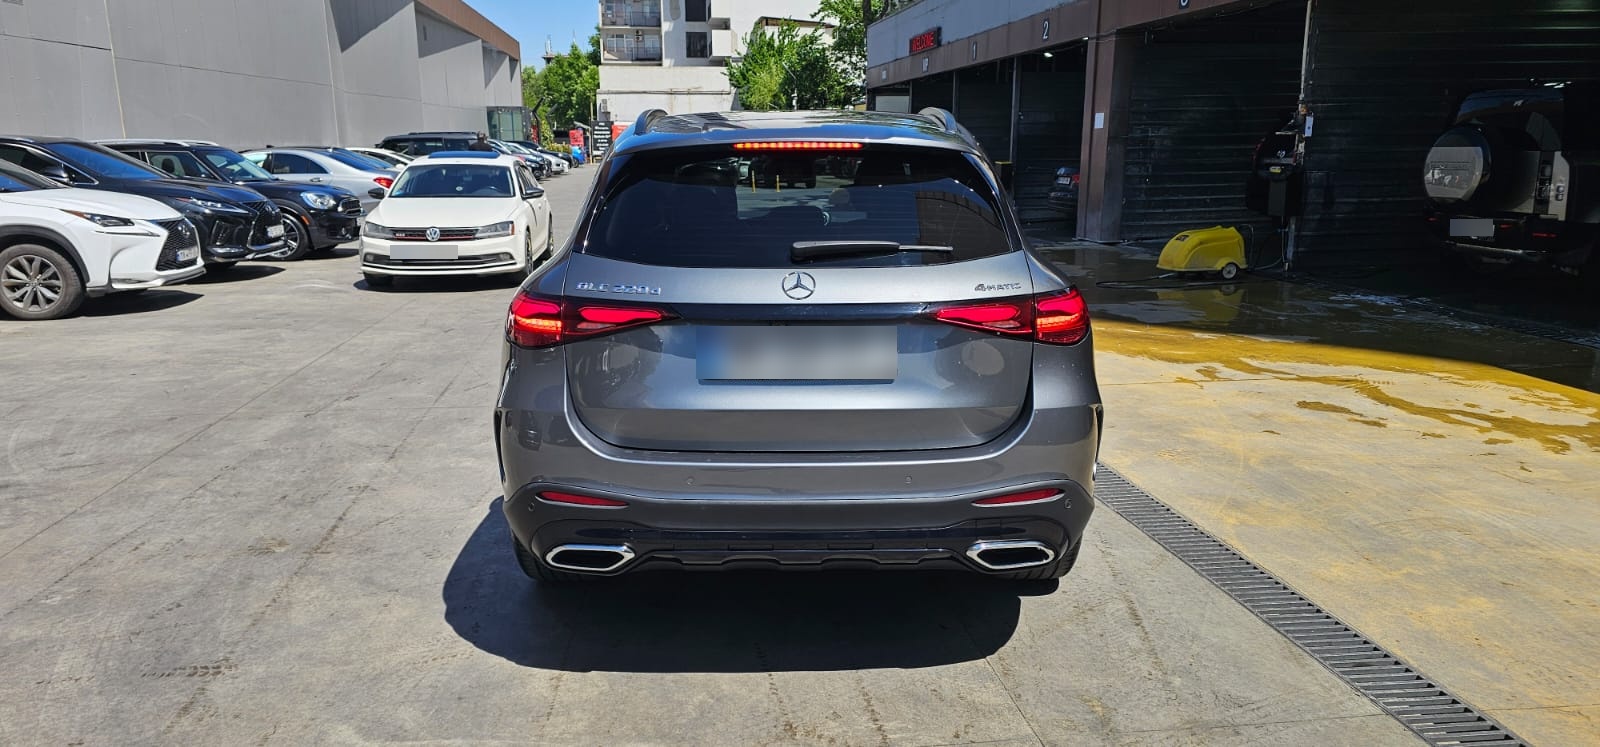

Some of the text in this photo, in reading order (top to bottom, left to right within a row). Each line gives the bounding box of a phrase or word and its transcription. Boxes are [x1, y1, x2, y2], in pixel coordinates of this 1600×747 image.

[1043, 20, 1049, 39] 2
[912, 31, 935, 53] WELCOME
[974, 283, 1021, 291] 4MATIC
